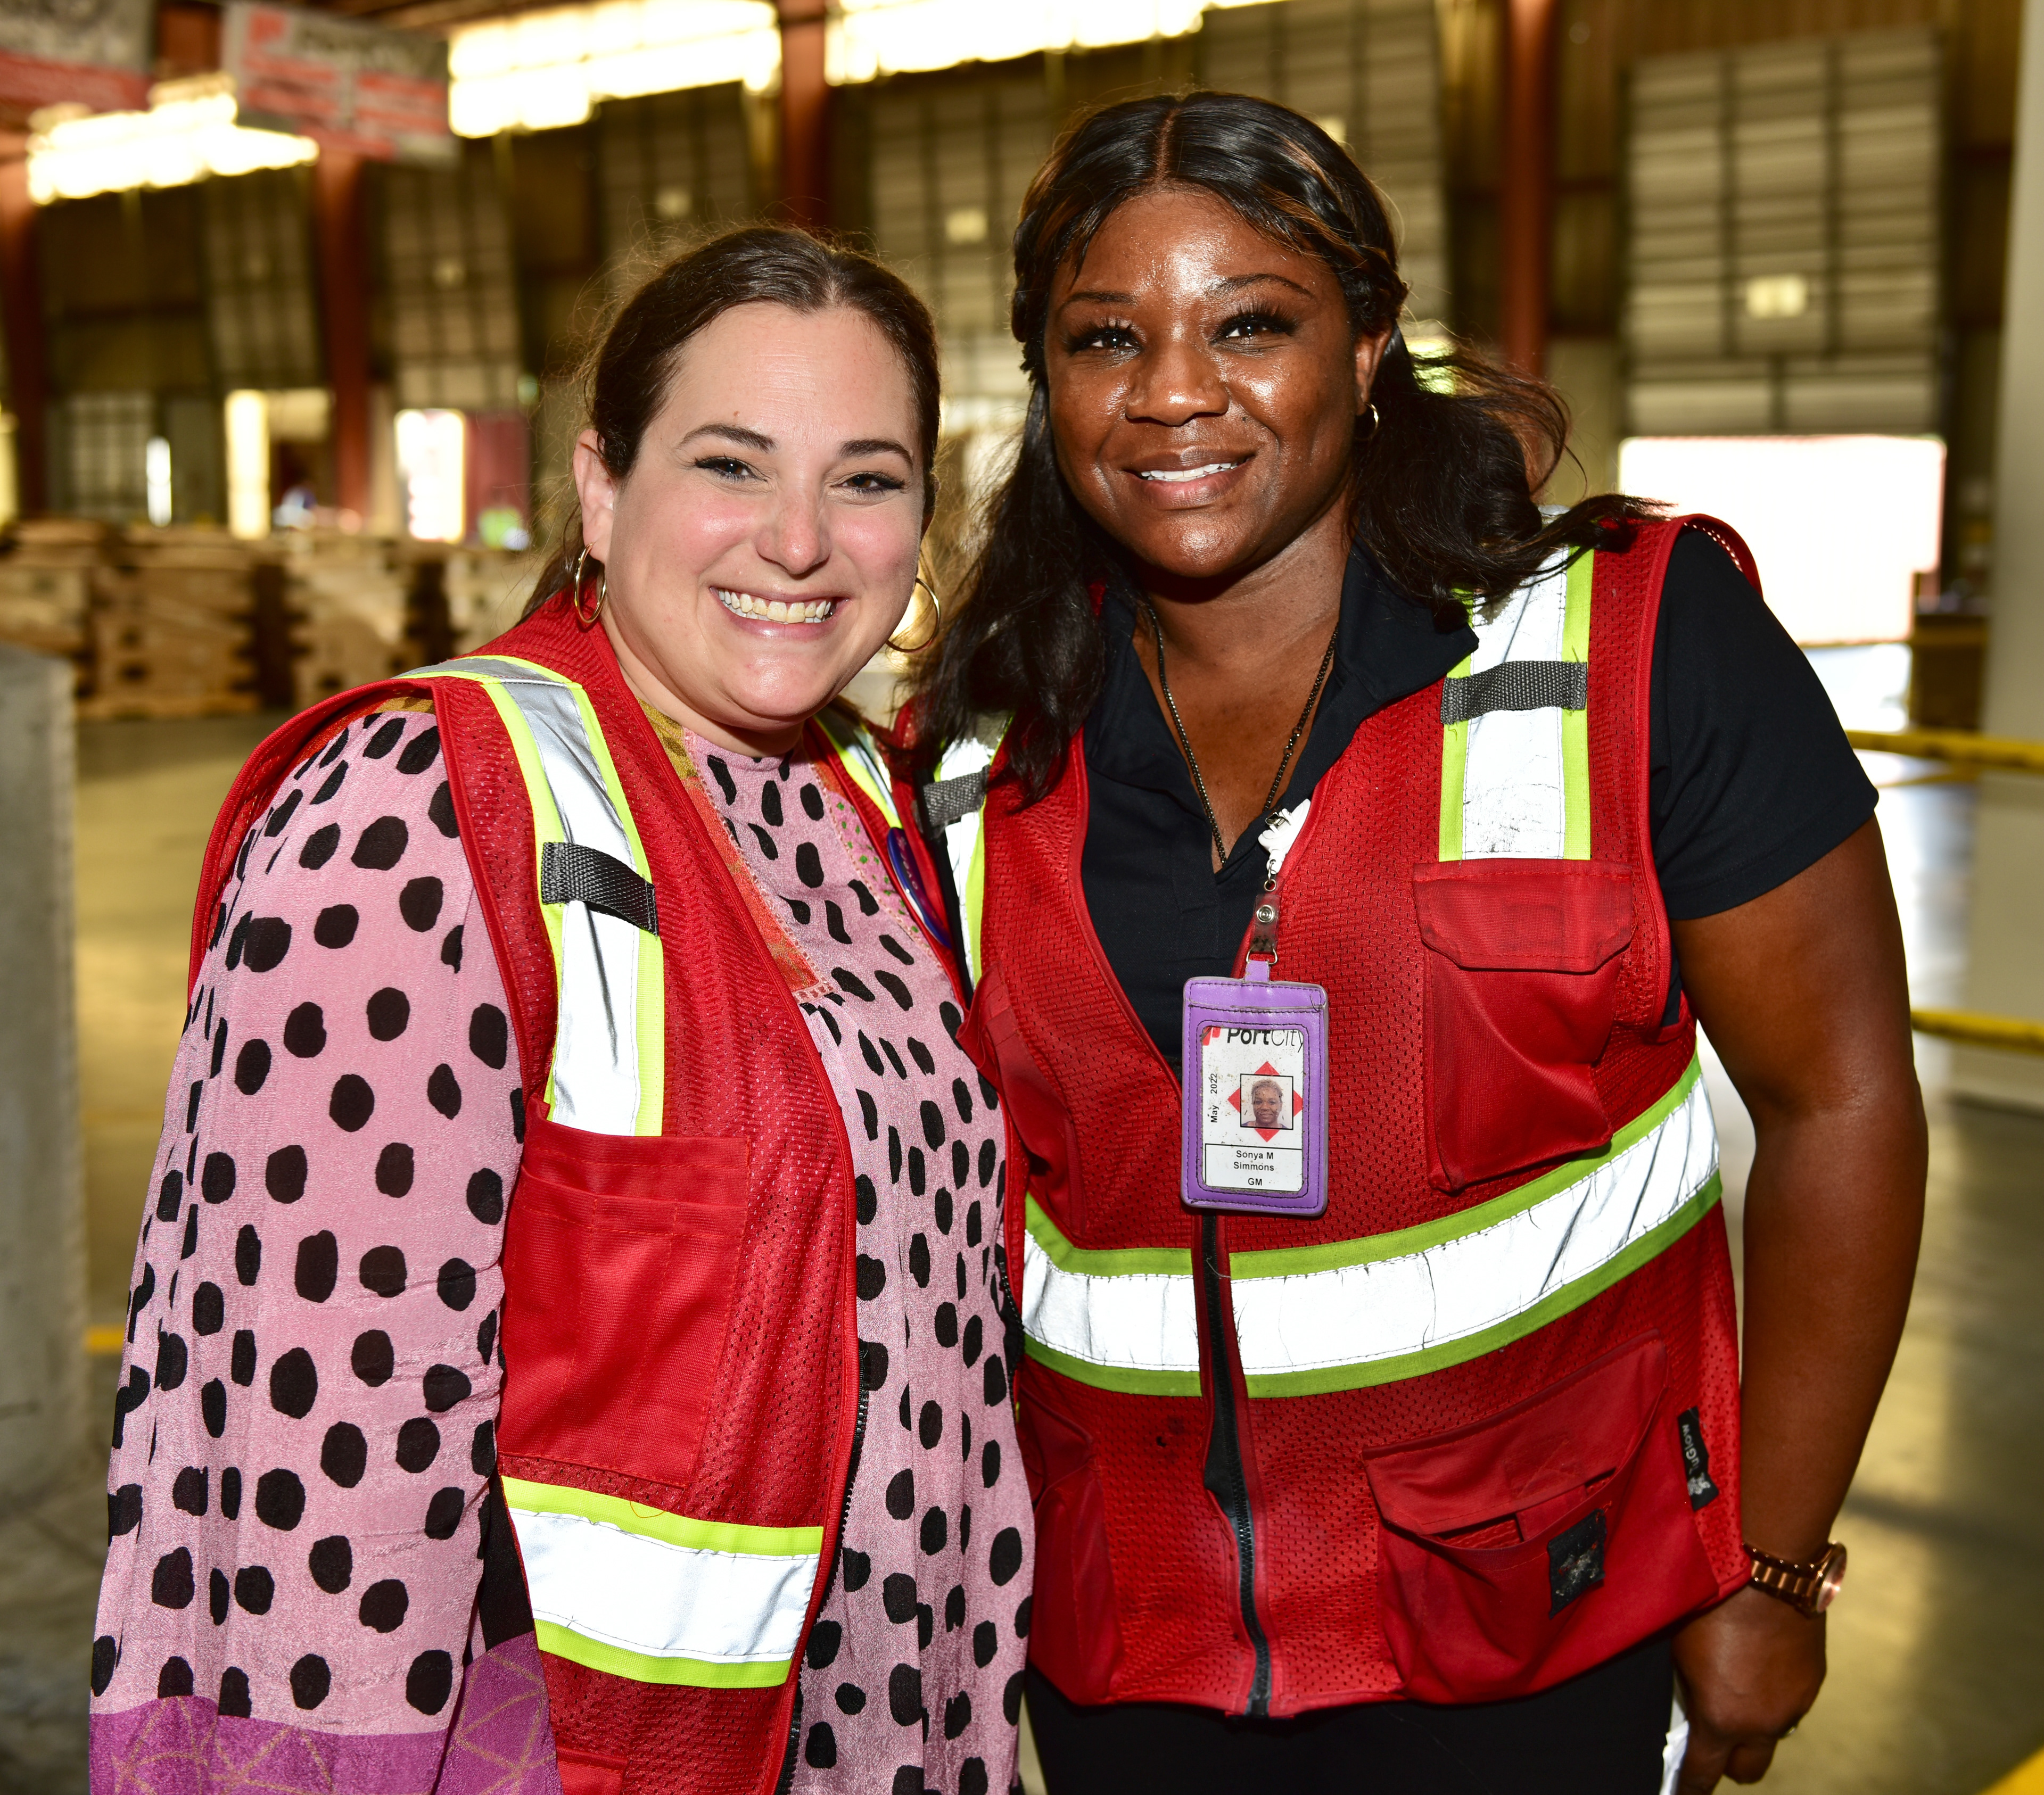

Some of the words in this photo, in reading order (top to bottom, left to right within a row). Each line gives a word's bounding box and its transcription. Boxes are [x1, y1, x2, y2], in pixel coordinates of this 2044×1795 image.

[1227, 1029, 1304, 1053] PortCity
[1210, 1105, 1219, 1123] May
[1236, 1150, 1263, 1160] Sonya
[1233, 1161, 1274, 1171] Simmons
